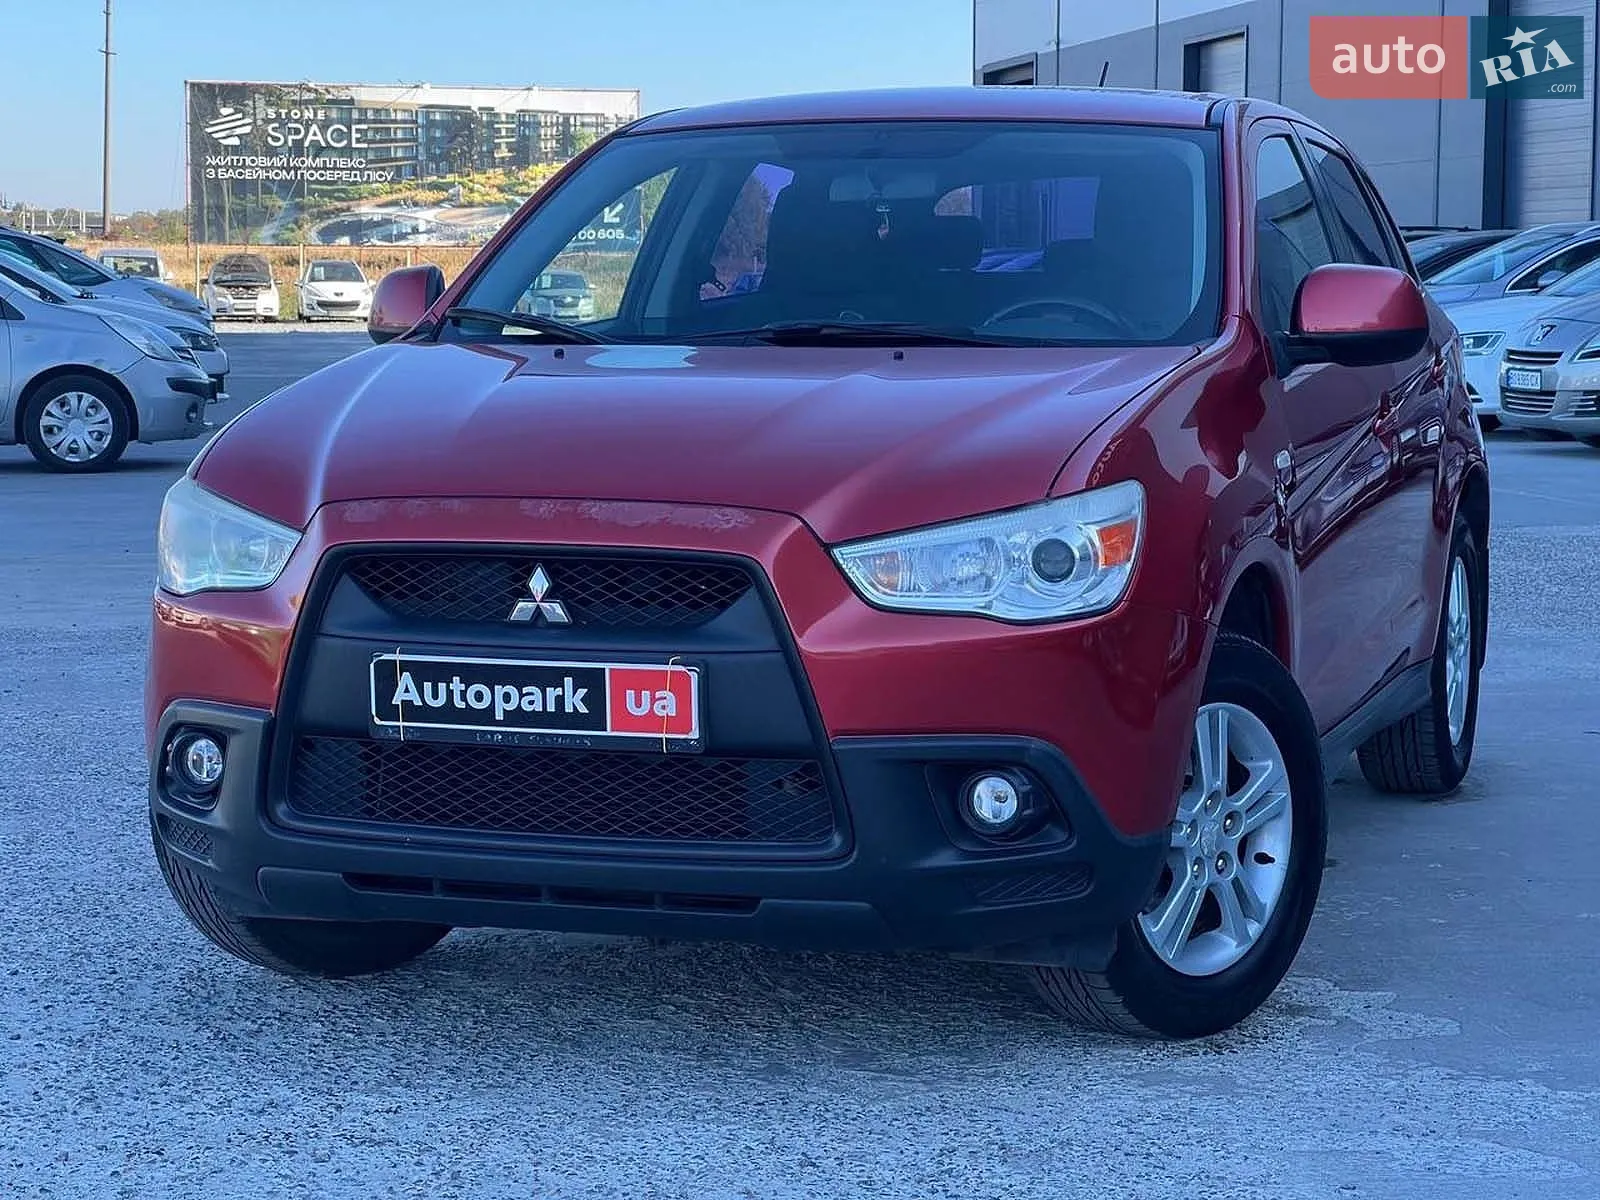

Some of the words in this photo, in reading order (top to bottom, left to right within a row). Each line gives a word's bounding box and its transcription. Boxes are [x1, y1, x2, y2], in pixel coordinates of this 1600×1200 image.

[267, 108, 328, 120] STONE
[266, 123, 368, 148] SPACE
[206, 154, 287, 168] ЖИТЛОВИЙ
[290, 157, 366, 169] КОМПЛЕКС
[218, 168, 295, 181] БАСЕЙНОМ
[297, 170, 362, 182] ПОСЕРЕД
[363, 171, 394, 182] ЛІСУ
[391, 671, 589, 720] Autopark
[625, 688, 678, 718] ua
